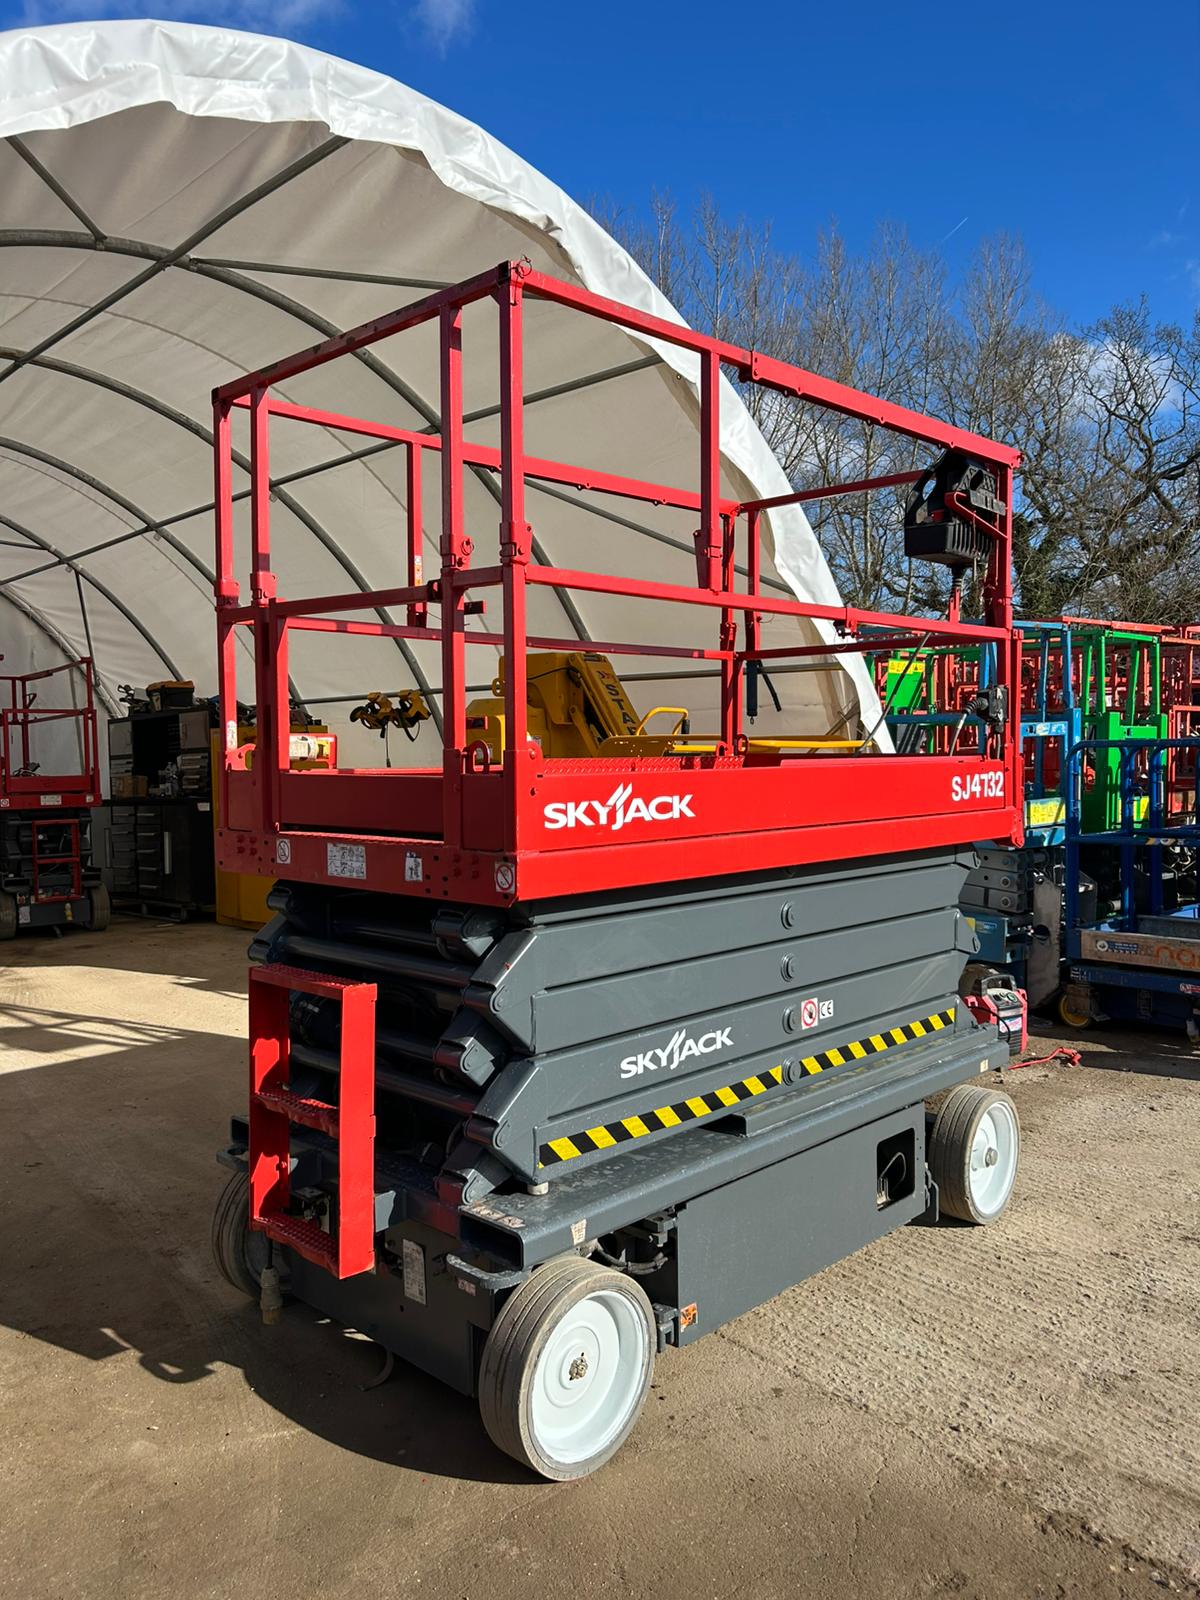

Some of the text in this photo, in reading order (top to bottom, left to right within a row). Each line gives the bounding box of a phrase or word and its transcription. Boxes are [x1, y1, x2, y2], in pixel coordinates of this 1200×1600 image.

[543, 782, 697, 831] SKYJACK
[951, 770, 1004, 801] SJ4732
[619, 1026, 735, 1079] SKYJACK
